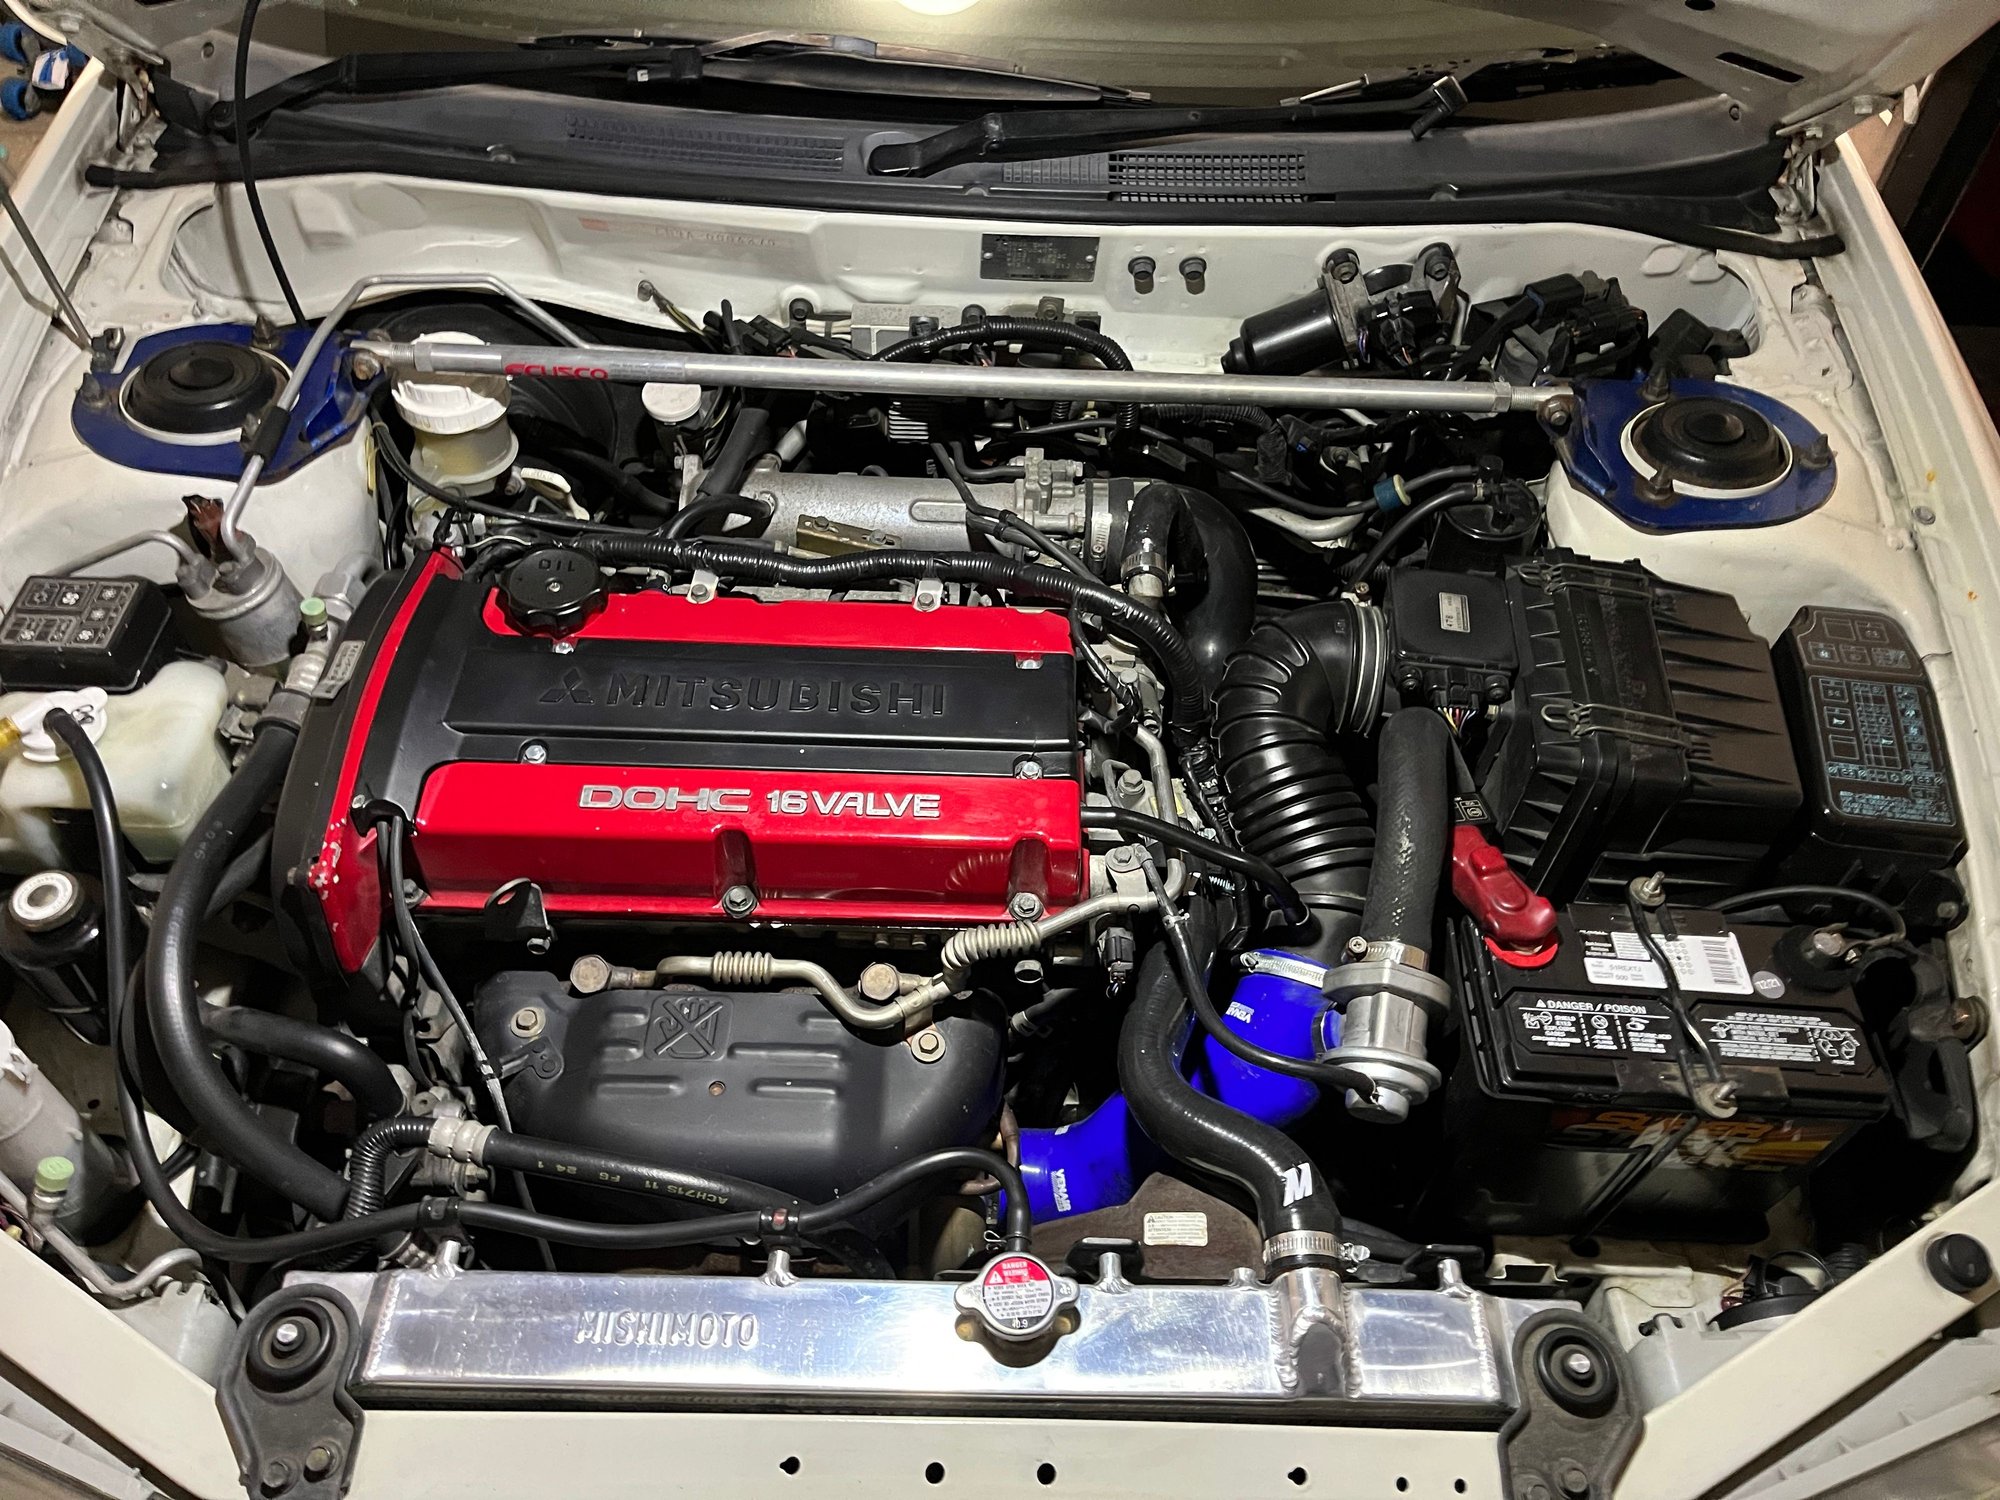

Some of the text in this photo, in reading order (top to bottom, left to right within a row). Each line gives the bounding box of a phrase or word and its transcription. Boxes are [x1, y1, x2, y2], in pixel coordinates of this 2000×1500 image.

[539, 559, 575, 572] OIL
[606, 673, 944, 715] MITSUBISHI
[578, 784, 751, 813] DOHC
[1547, 1000, 1595, 1011] DANGER
[1604, 1004, 1647, 1014] POISON
[574, 1308, 759, 1350] MISHIMOTO
